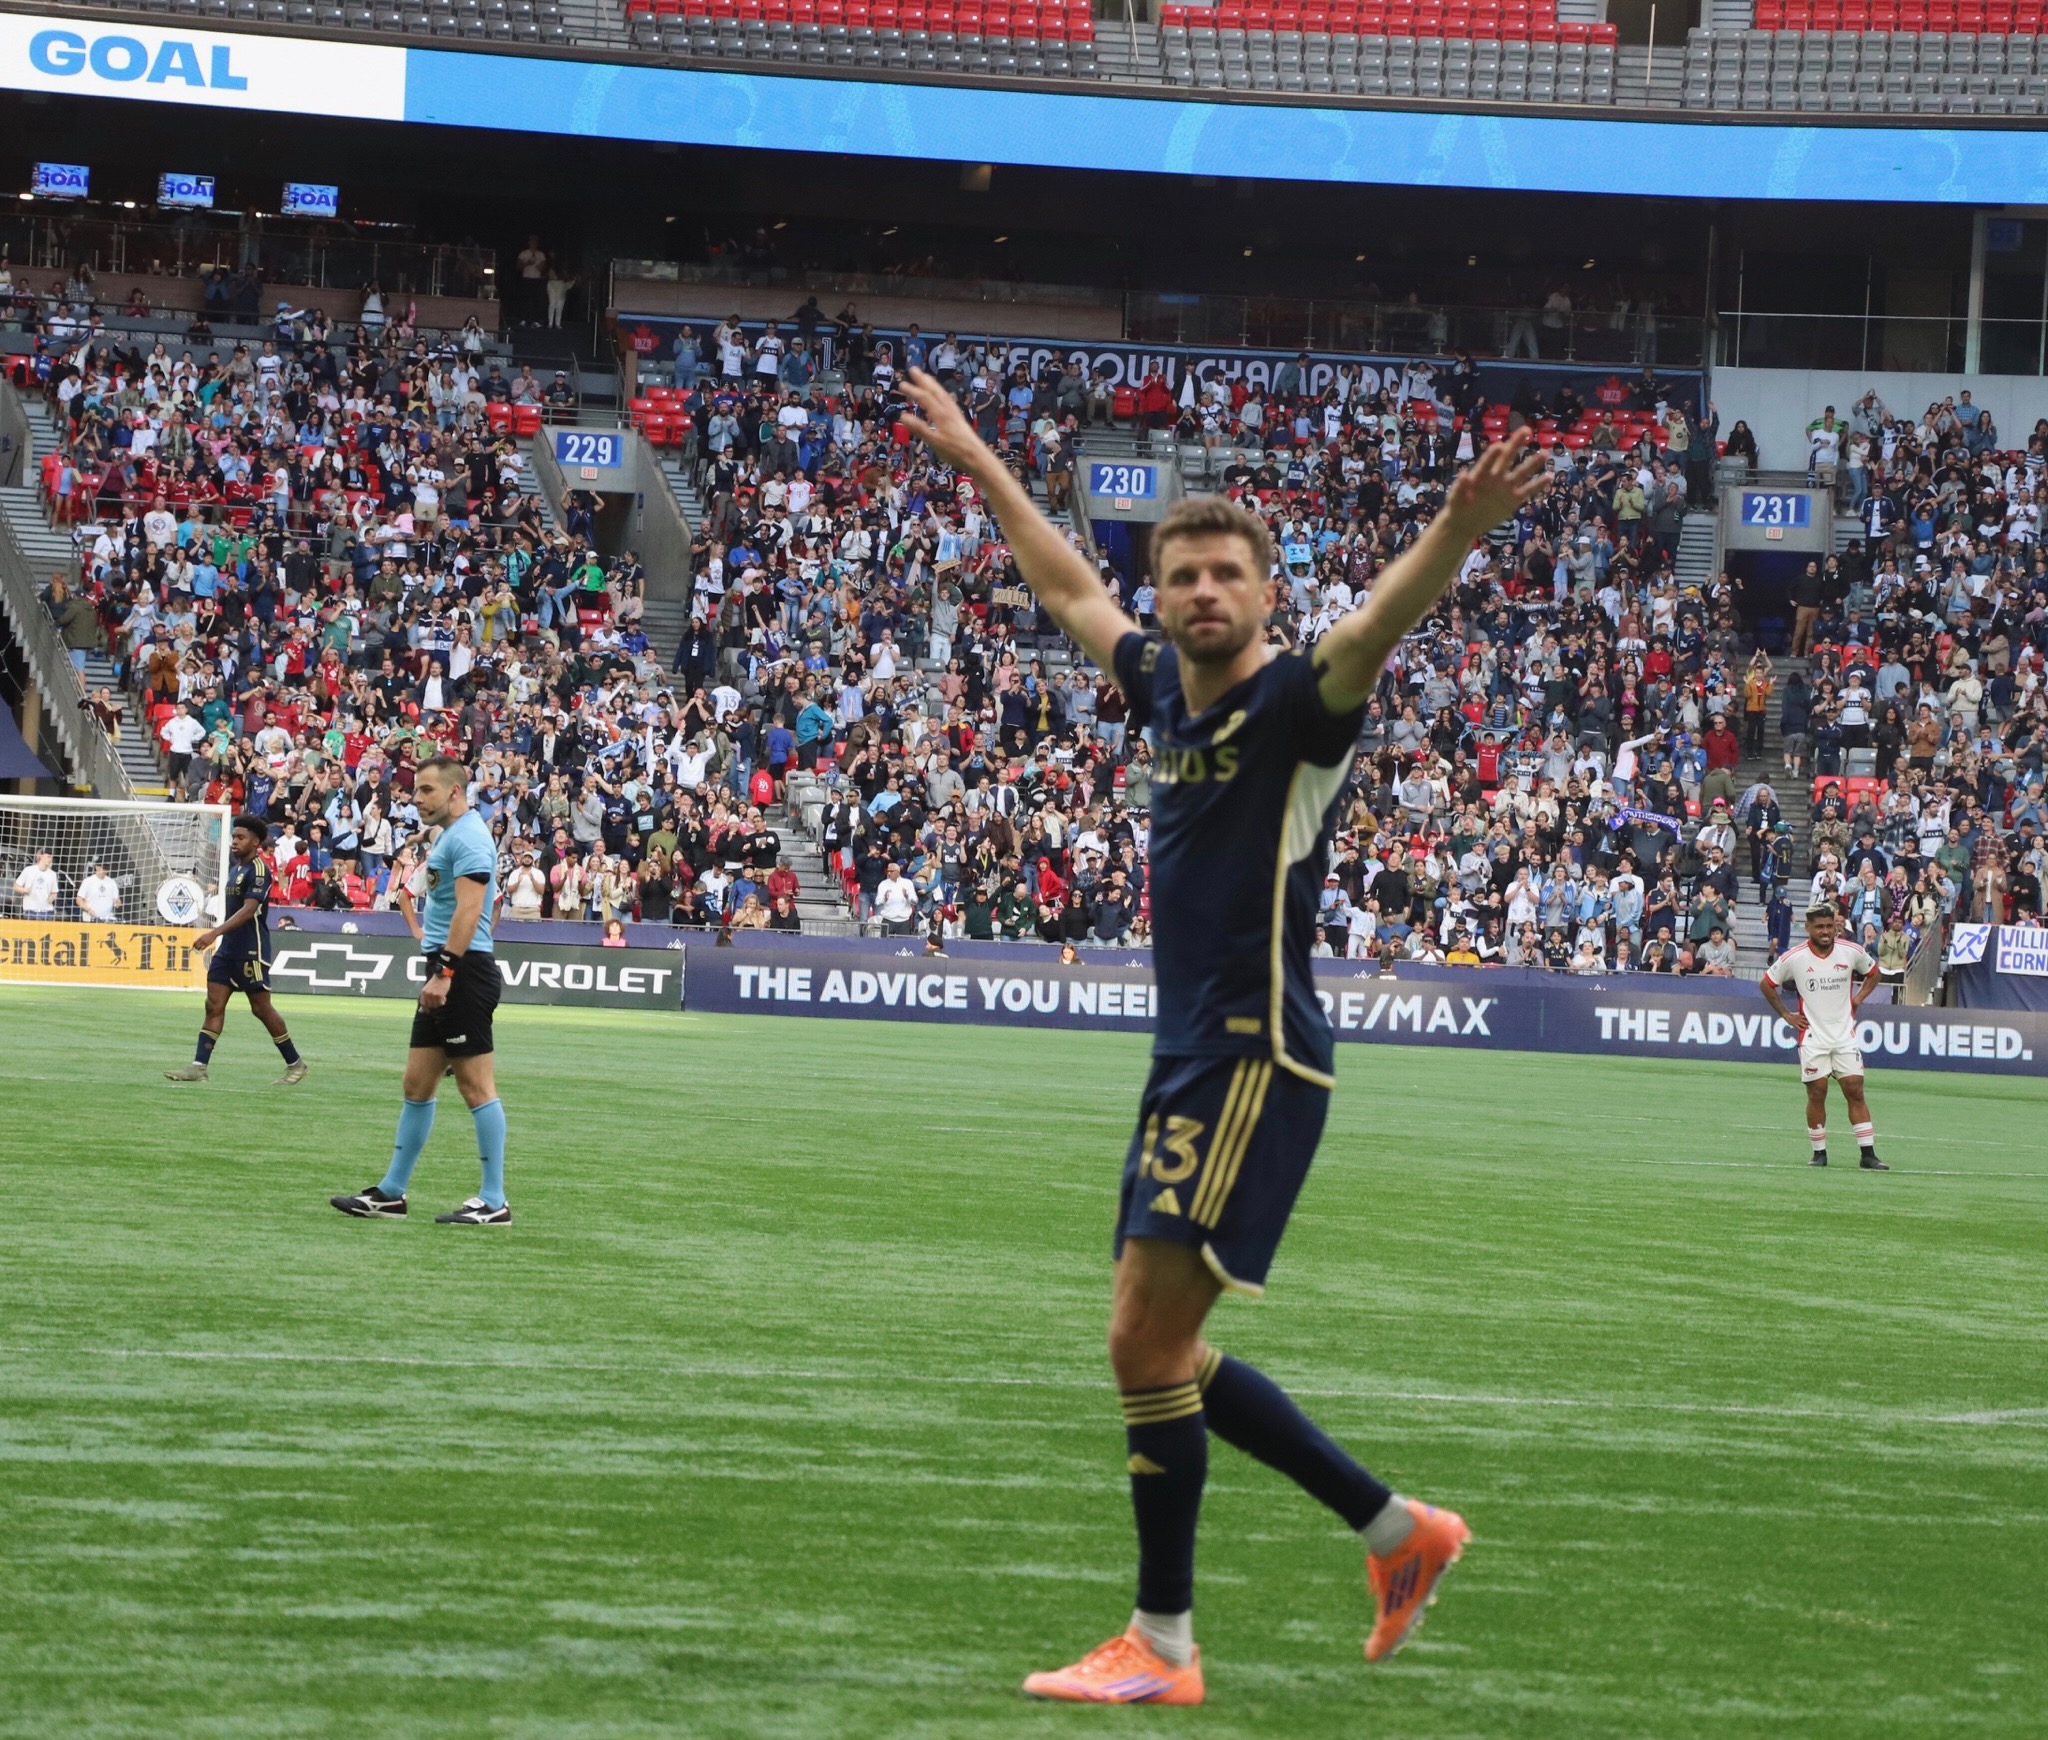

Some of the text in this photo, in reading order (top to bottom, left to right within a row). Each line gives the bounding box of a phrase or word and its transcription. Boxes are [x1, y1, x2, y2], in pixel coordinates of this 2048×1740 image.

[29, 29, 248, 91] GOAL
[565, 434, 612, 464] 229
[583, 468, 596, 478] EXIT
[1099, 466, 1146, 495] 230
[1751, 496, 1796, 524] 231
[944, 855, 957, 863] Bell
[407, 956, 672, 995] CVROLET
[733, 965, 812, 1001] THE
[819, 969, 968, 1009] ADVICE
[977, 977, 1061, 1013] YOU
[1820, 984, 1840, 992] Health
[1595, 1007, 2033, 1061] THE ADVIC OU NEED.
[1139, 1111, 1205, 1184] 13
